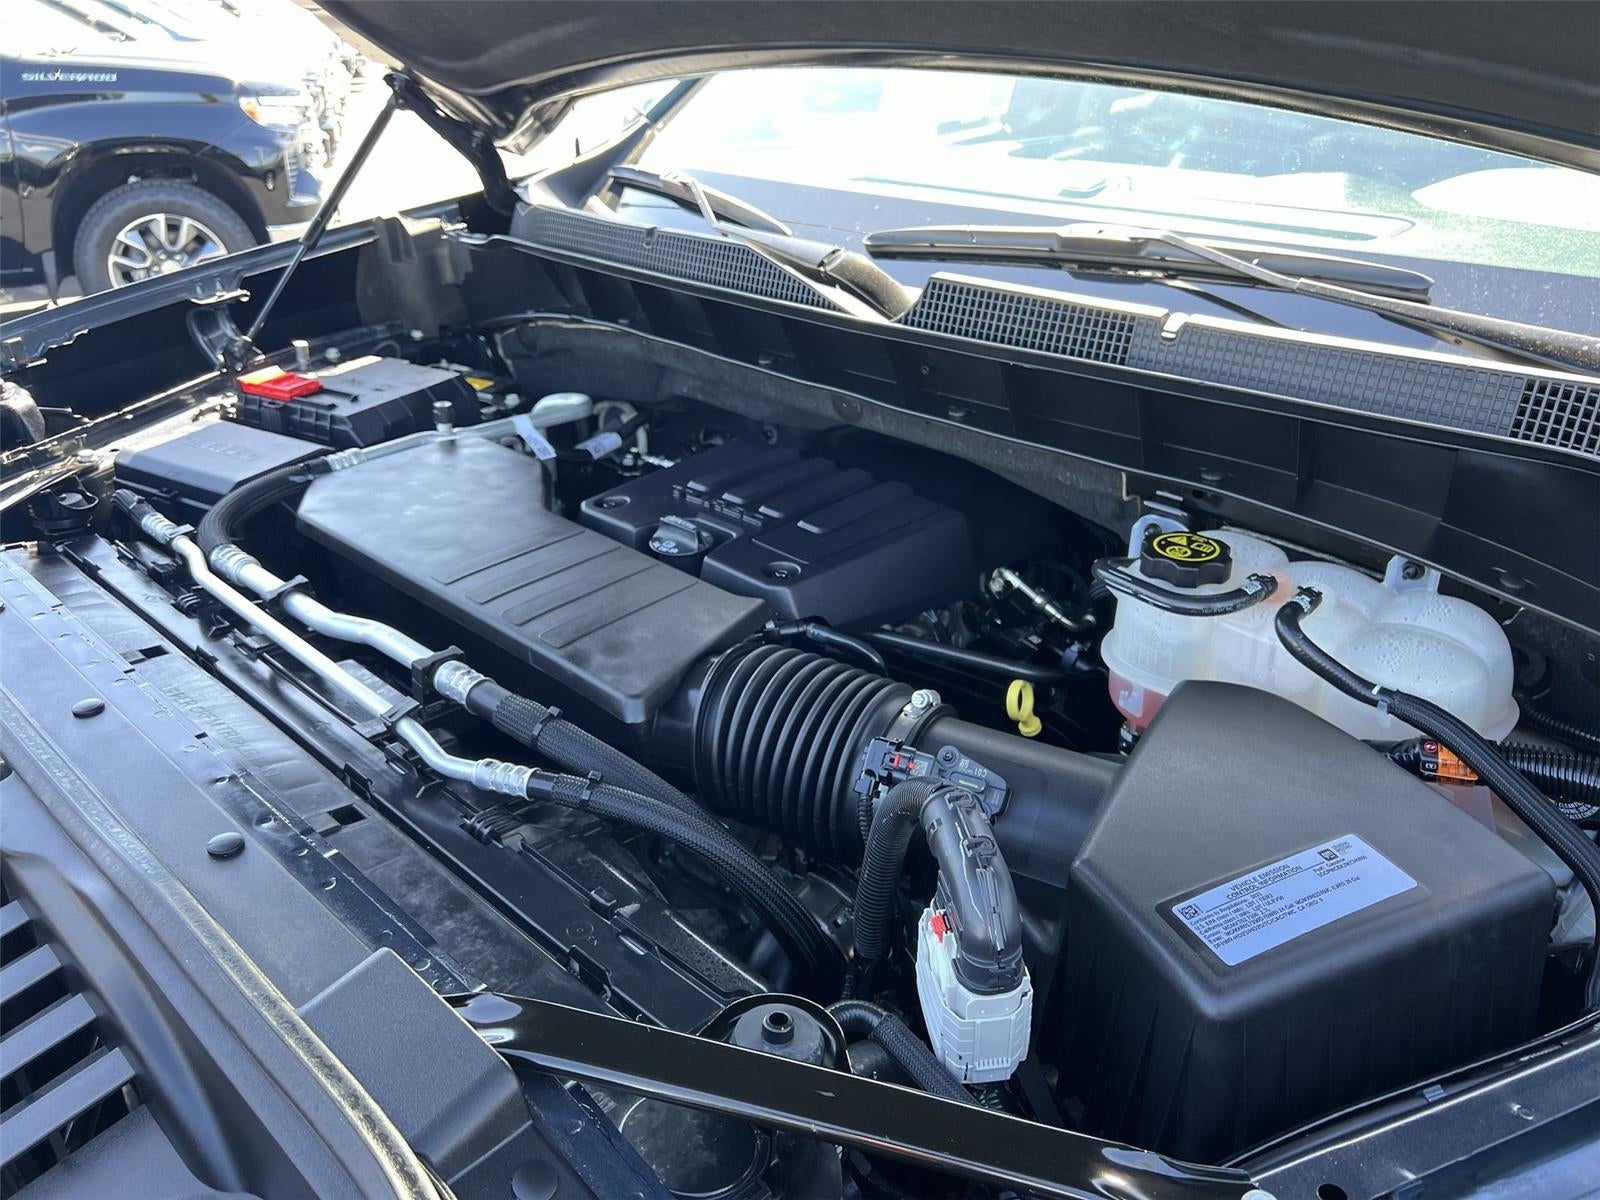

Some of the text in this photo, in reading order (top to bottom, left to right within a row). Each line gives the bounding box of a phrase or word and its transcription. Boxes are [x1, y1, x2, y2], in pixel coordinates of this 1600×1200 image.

[21, 70, 118, 82] SILVERADO
[1226, 865, 1303, 899] CONTROL INFORMATION
[1230, 864, 1290, 891] VEHICLE EMISSION
